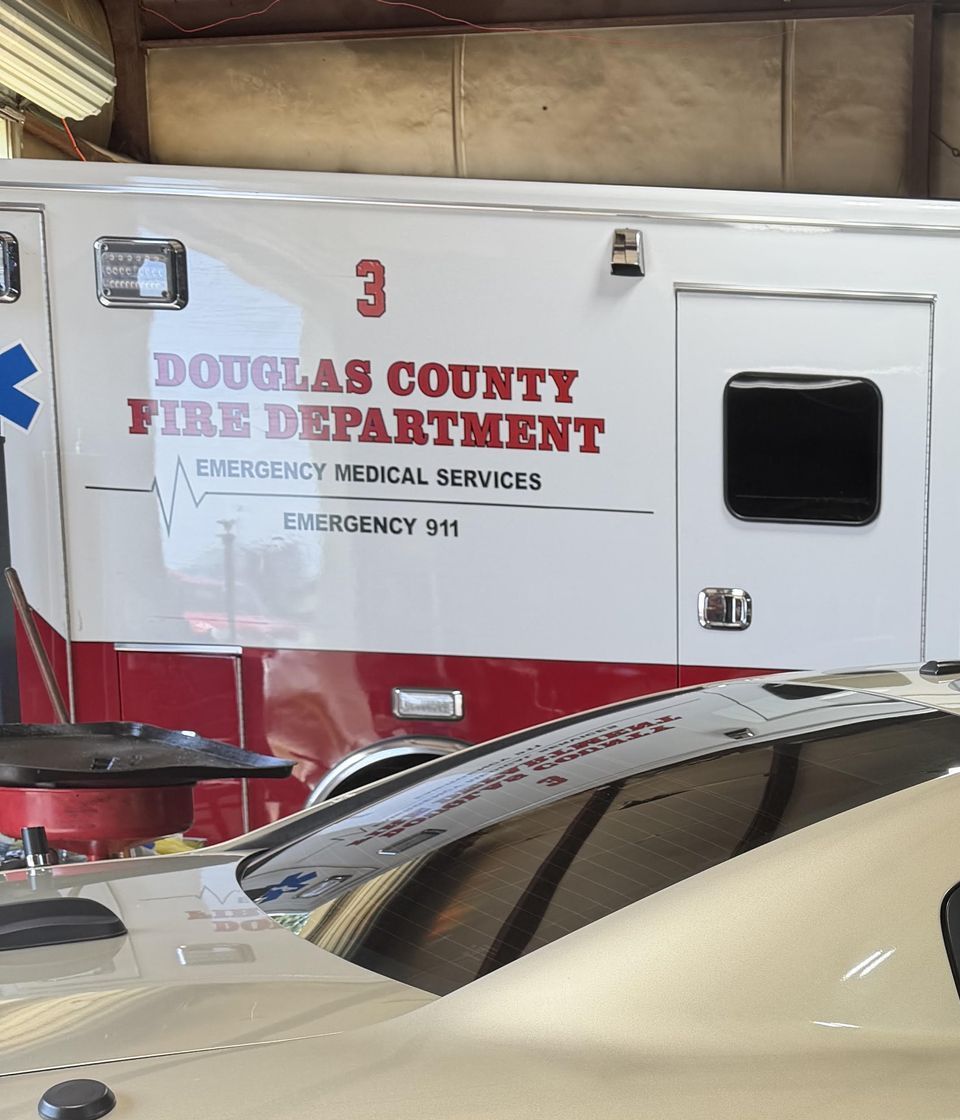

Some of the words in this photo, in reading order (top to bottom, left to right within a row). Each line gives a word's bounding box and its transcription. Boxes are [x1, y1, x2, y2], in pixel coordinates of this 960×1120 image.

[355, 258, 386, 318] 3
[153, 352, 373, 395] DOUGLAS
[386, 360, 579, 404] COUNTY
[127, 398, 251, 439] FIRE
[264, 402, 605, 454] DEPARTMENT
[195, 458, 327, 481] EMERGENCY
[335, 463, 428, 486] MEDICAL
[436, 468, 542, 491] SERVICES
[283, 511, 417, 535] EMERGENCY
[426, 517, 459, 538] 911
